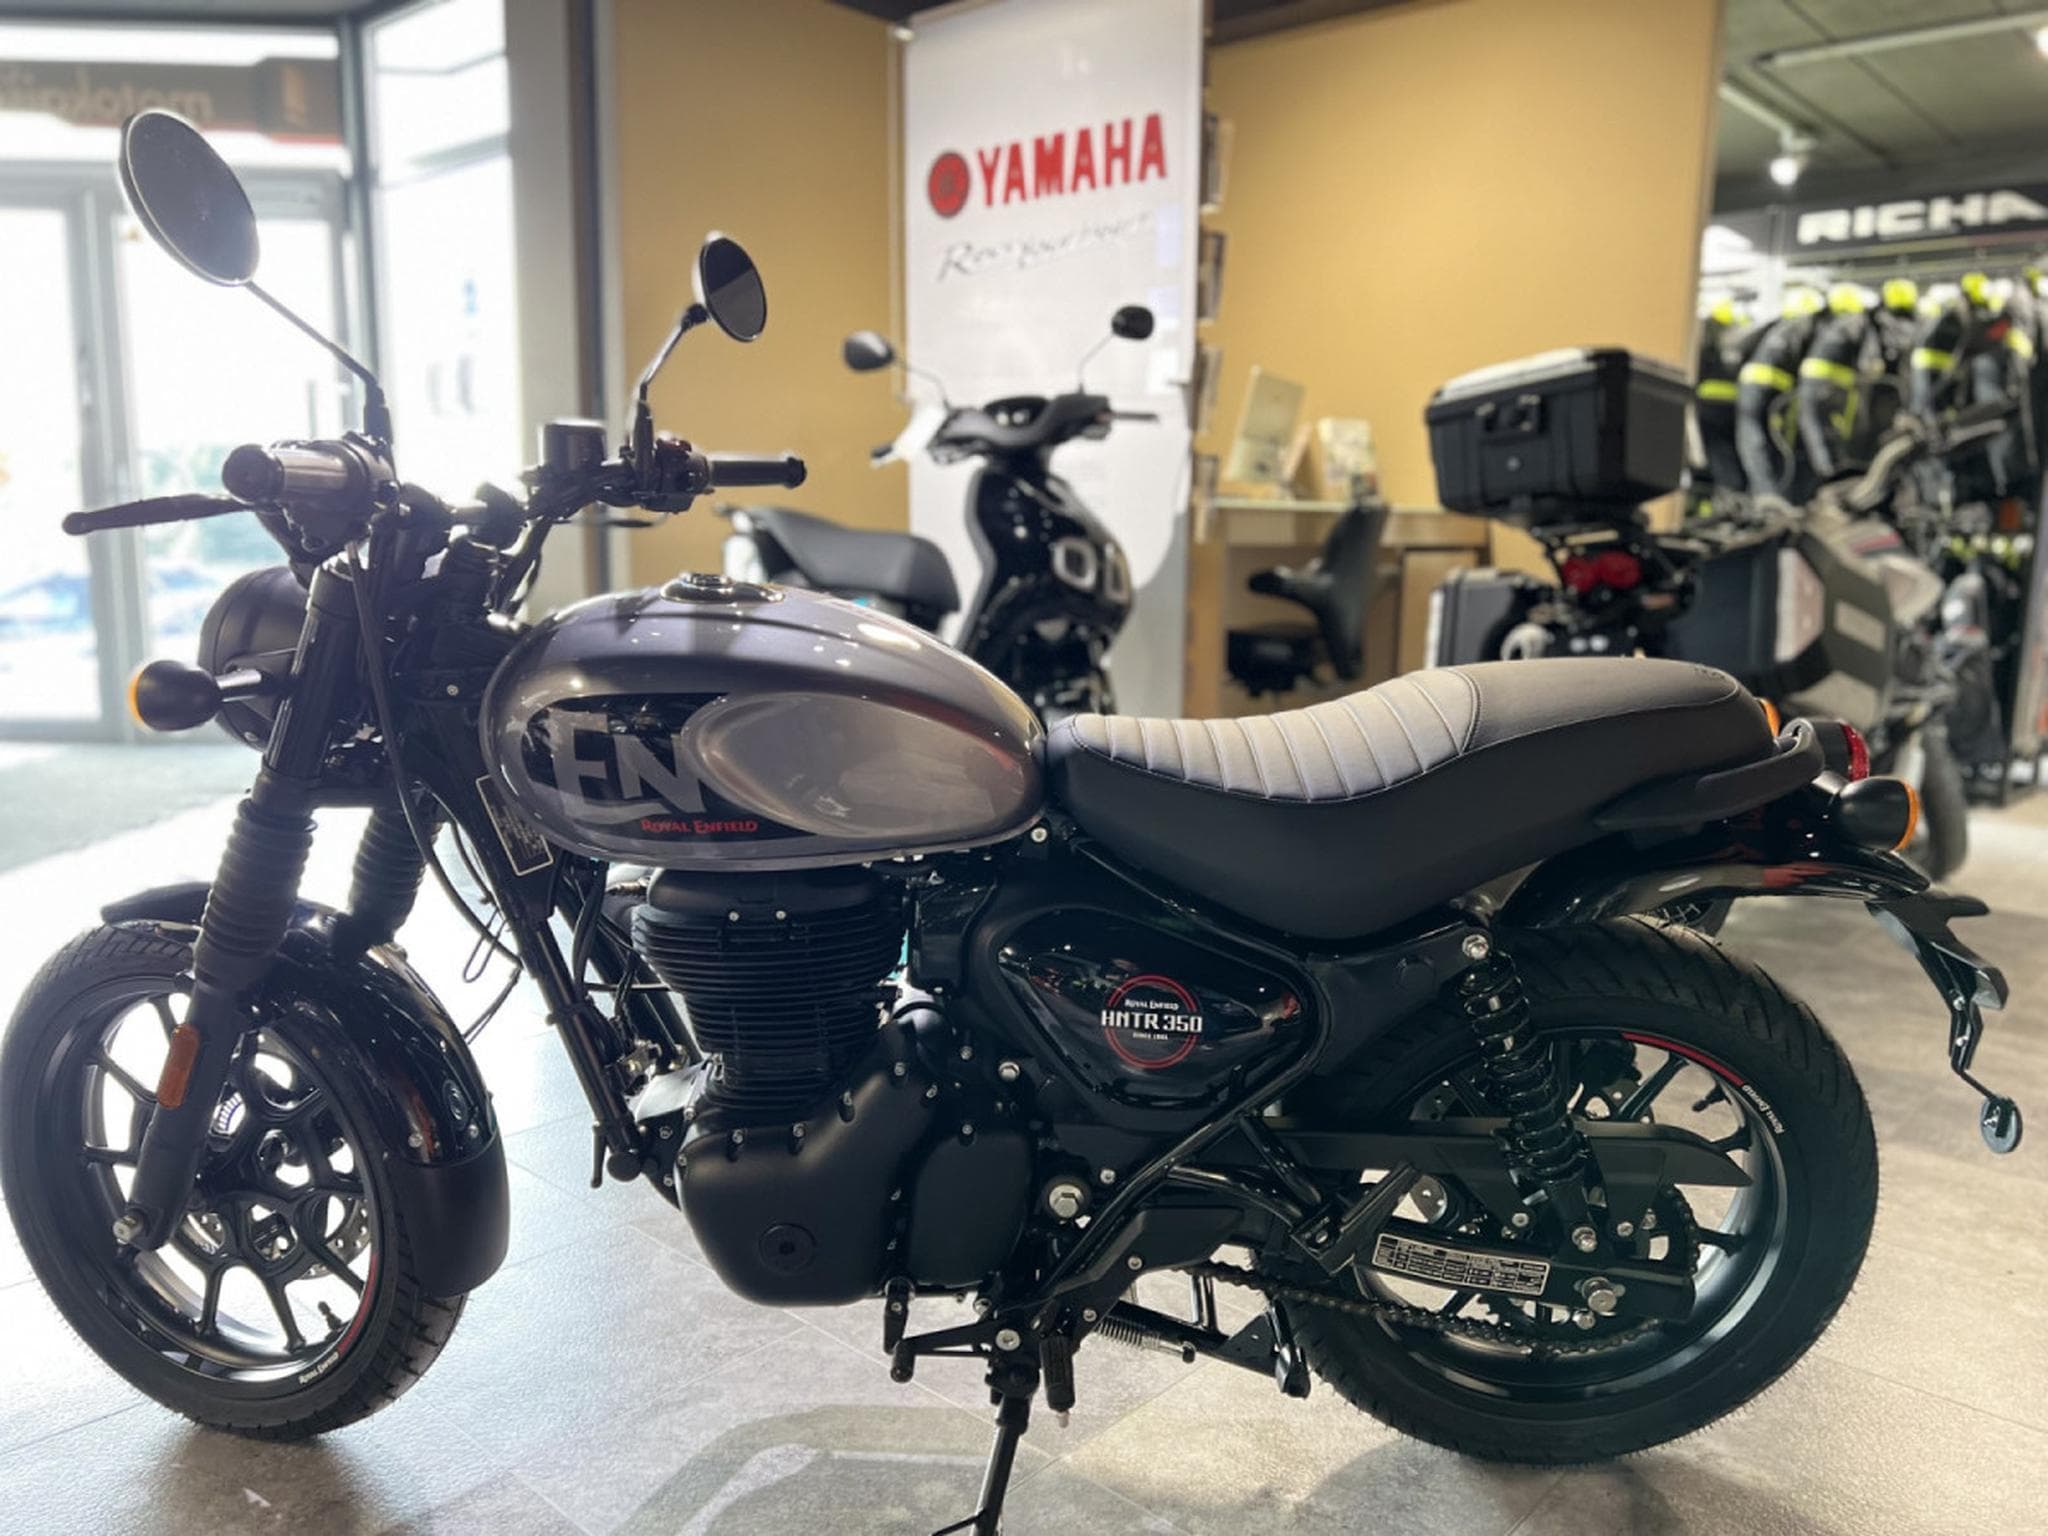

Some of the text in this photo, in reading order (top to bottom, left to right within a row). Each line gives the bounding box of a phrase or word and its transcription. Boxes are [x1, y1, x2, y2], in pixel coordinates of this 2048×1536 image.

[977, 112, 1167, 208] YAMAHA
[1797, 190, 2047, 245] RICHA
[641, 818, 758, 834] ROYAL ENFIELD
[1124, 999, 1179, 1011] ROYAL ENFIELD
[1101, 1009, 1203, 1033] HNTR 350
